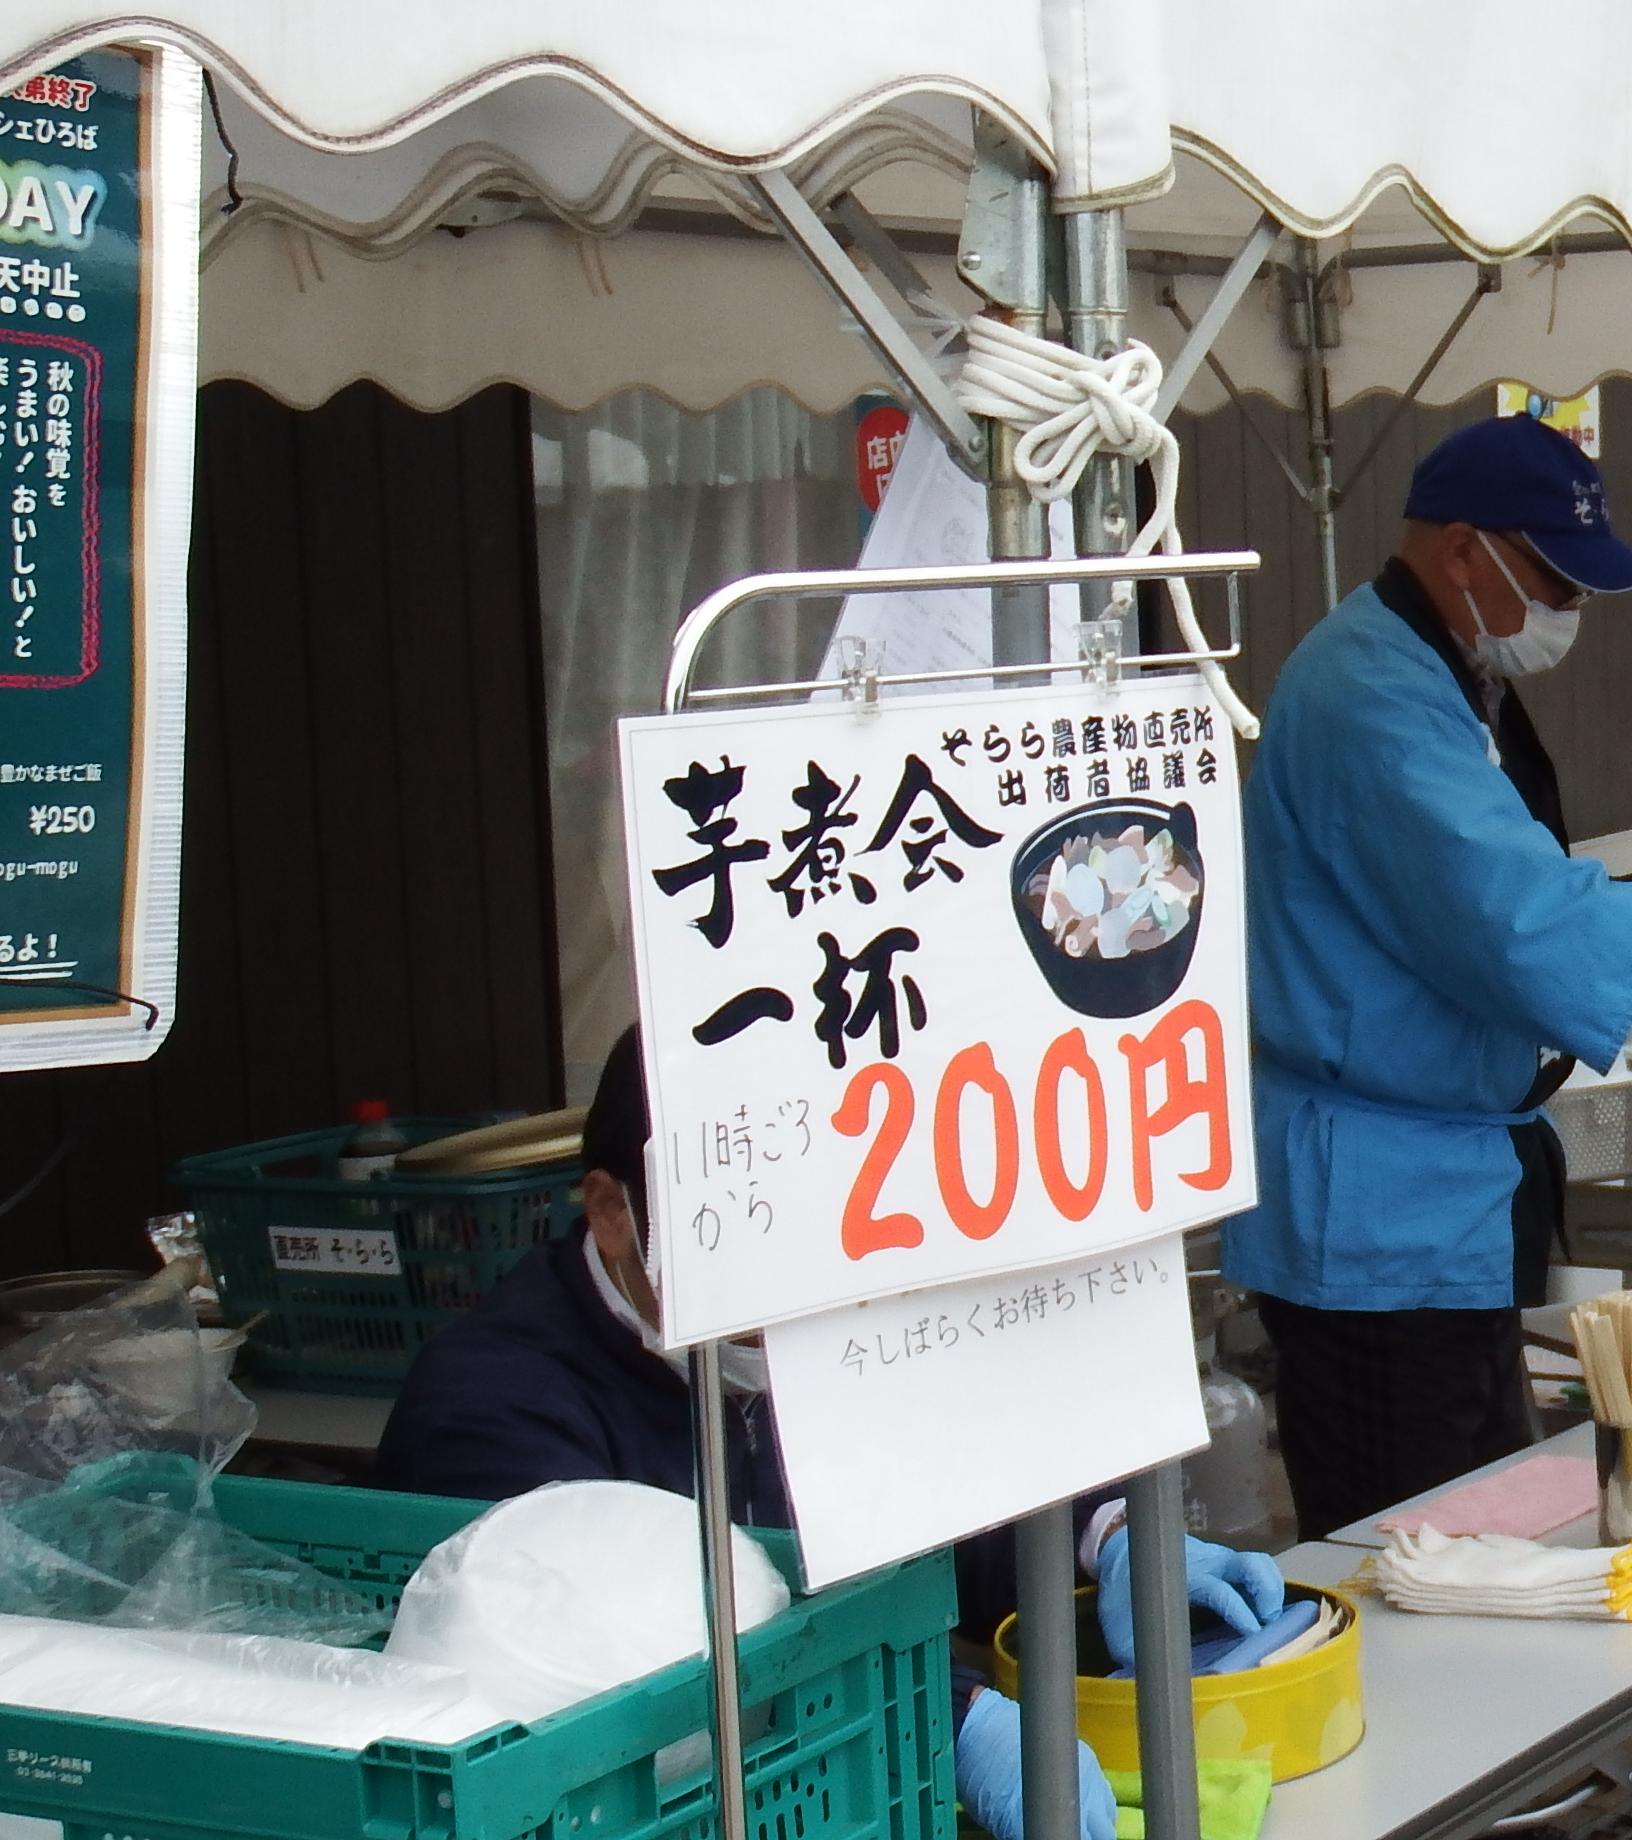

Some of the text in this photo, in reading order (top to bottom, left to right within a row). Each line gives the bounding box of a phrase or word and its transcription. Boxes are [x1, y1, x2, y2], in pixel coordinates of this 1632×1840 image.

[12, 75, 96, 111] 第終了
[0, 175, 96, 235] AY
[46, 361, 74, 507] 秋の味覚を
[941, 705, 1214, 767] そらら農産物直売所
[998, 748, 1217, 807] 出荷者協議会
[30, 805, 96, 835] ¥250
[652, 754, 1006, 948] 芋煮会
[692, 927, 928, 1069] 一杯
[673, 1100, 811, 1185] 11時ごろ
[831, 999, 1232, 1261] 200円
[693, 1181, 773, 1251] から
